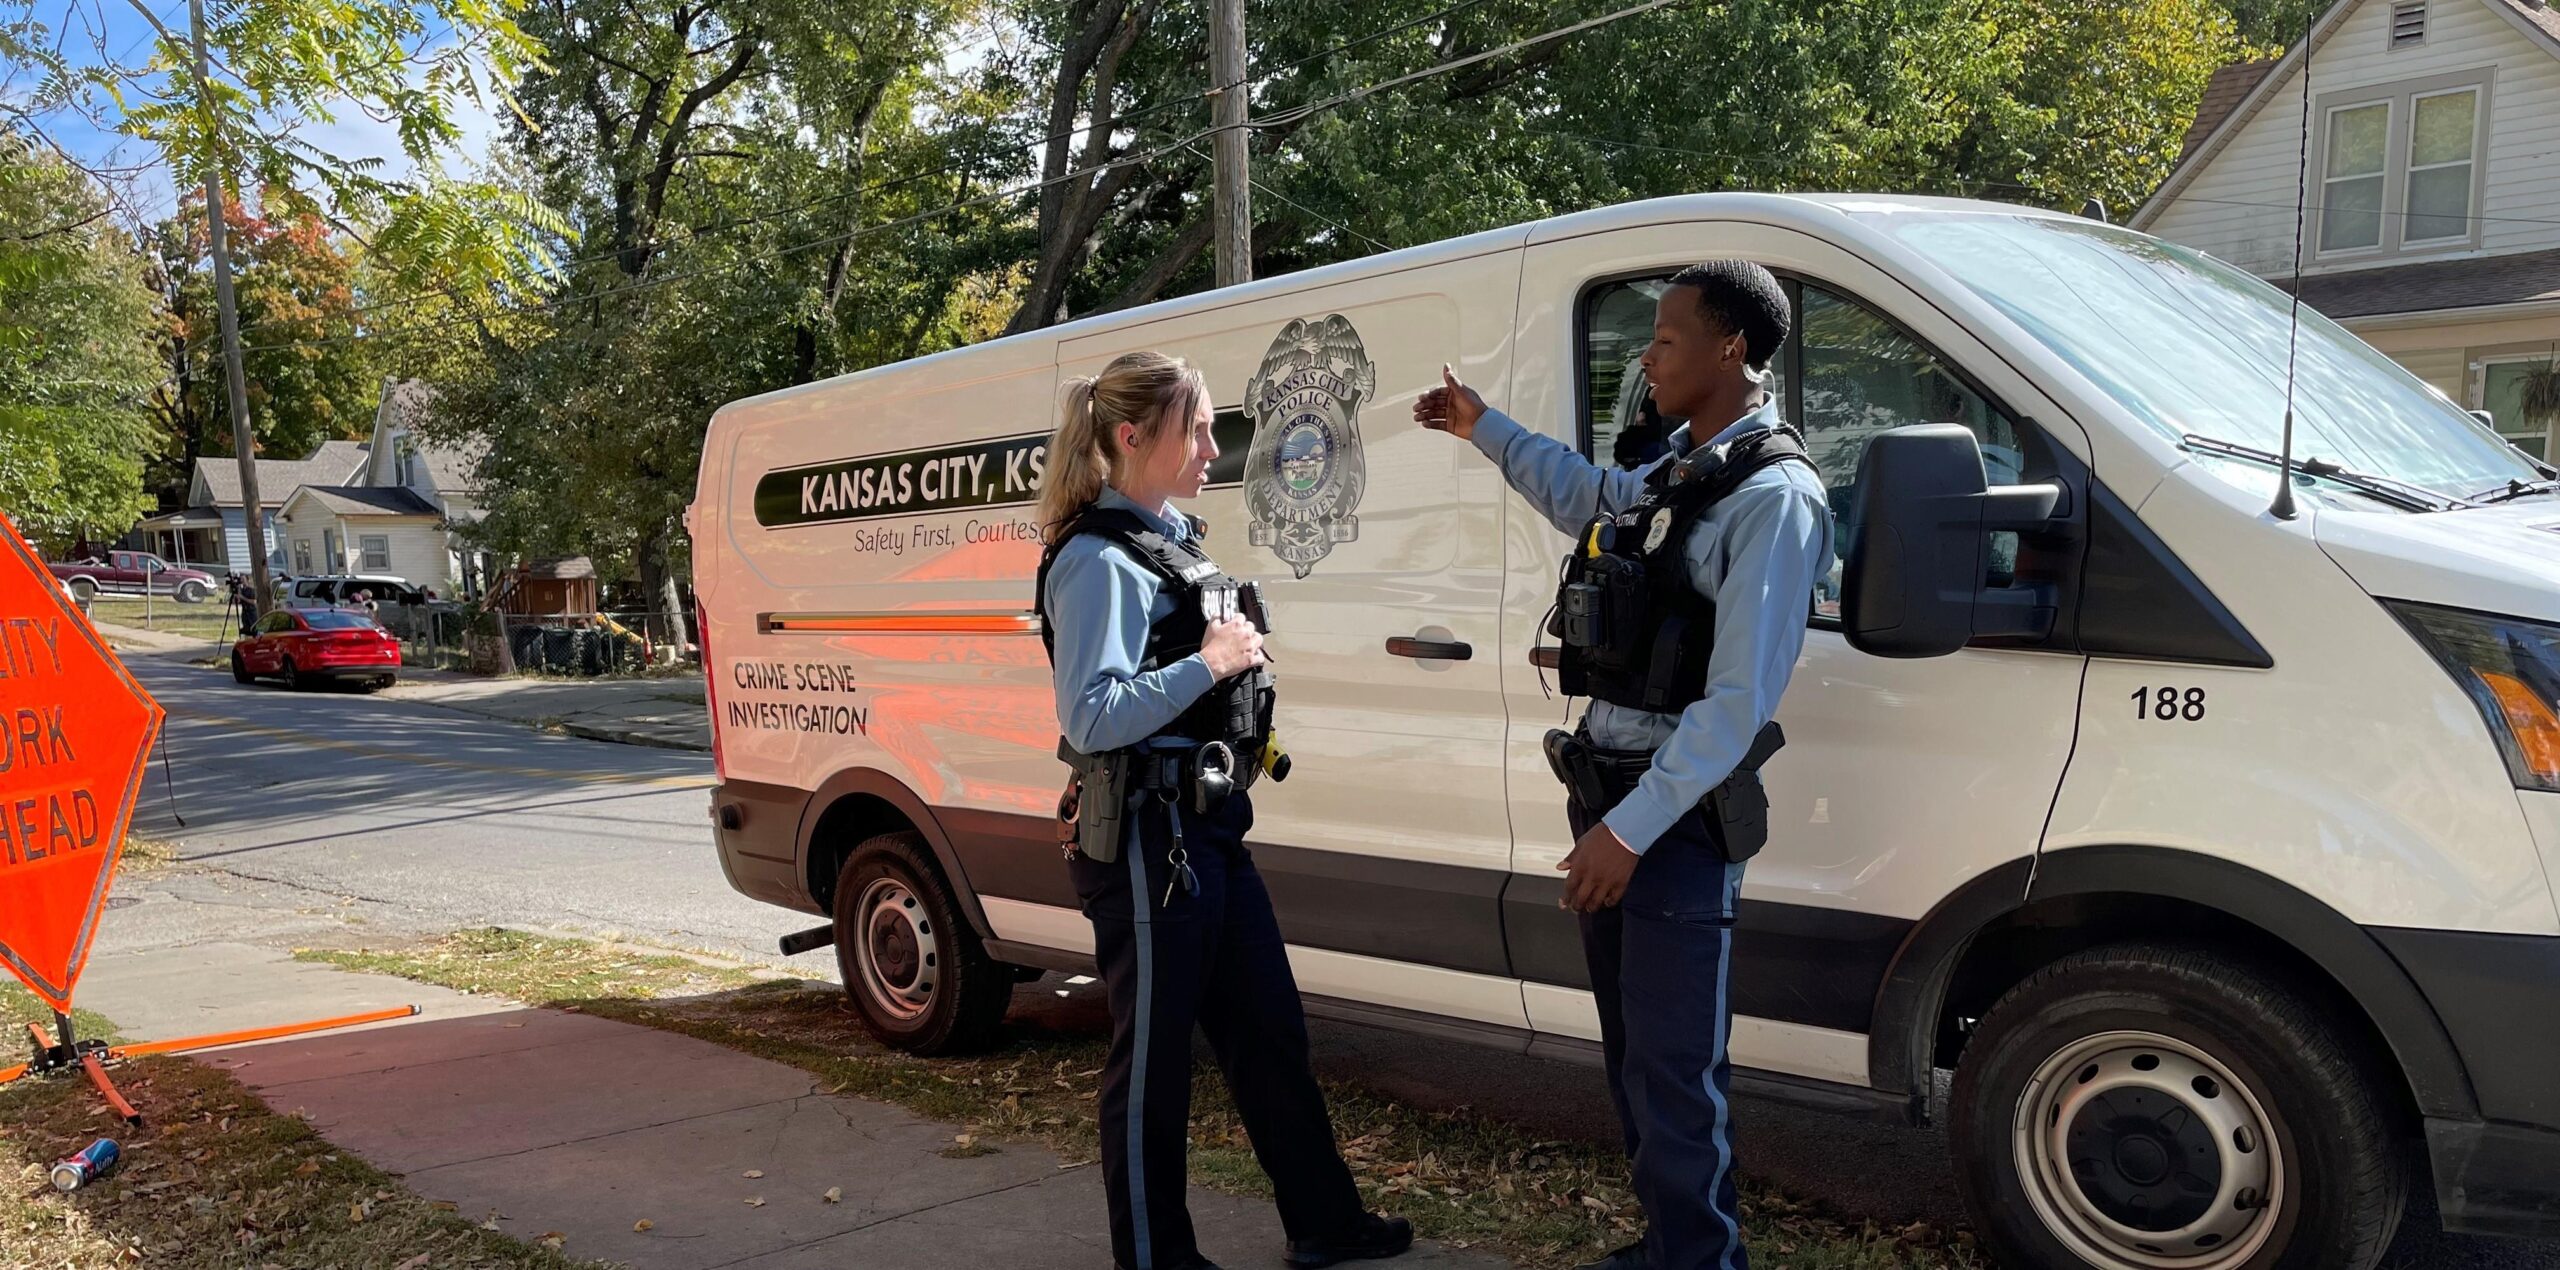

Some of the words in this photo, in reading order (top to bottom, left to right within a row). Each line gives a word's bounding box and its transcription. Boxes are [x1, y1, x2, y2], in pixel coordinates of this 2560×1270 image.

[1266, 371, 1316, 407] KANSAS
[1319, 373, 1350, 397] CITY
[1278, 391, 1333, 418] POLICE
[801, 462, 913, 514] KANSAS
[920, 453, 994, 502] CITY,
[1005, 446, 1047, 493] KS
[1262, 479, 1343, 522] DEPARTMENT
[854, 527, 904, 555] Safety
[912, 523, 955, 549] First,
[965, 518, 1043, 546] Courtes
[1279, 543, 1326, 561] KANSAS
[0, 618, 62, 678] ITY
[734, 662, 788, 690] CRIME
[794, 663, 856, 692] SCENE
[728, 701, 867, 736] INVESTIGATION
[2131, 686, 2205, 721] 188
